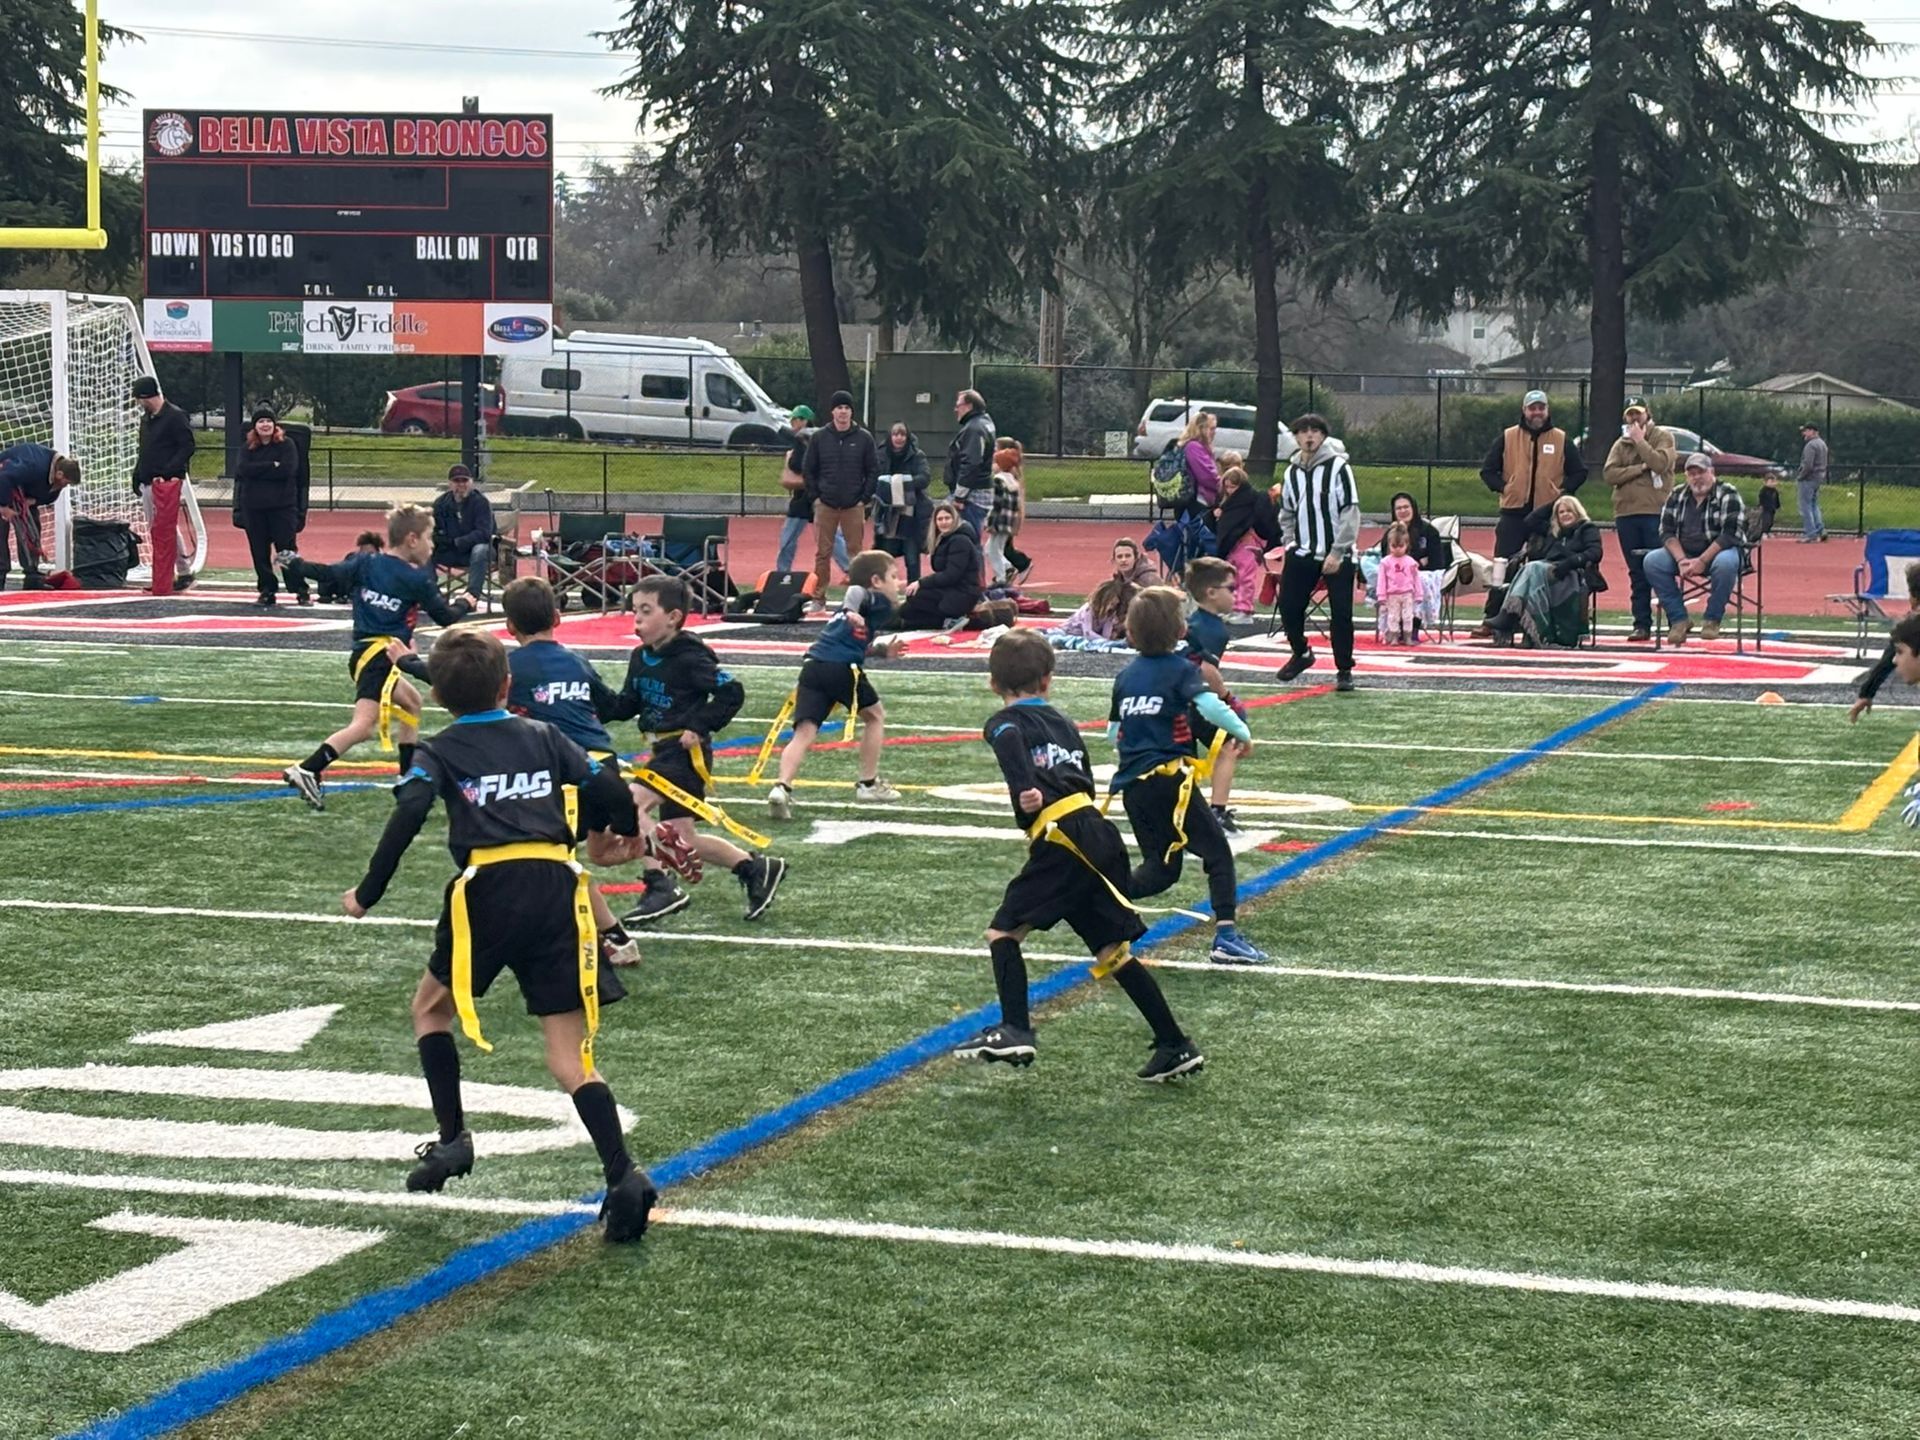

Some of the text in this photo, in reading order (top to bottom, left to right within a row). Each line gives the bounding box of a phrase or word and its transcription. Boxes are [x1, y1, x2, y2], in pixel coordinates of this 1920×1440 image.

[199, 116, 548, 157] BELLA VISTA BRONCOS
[151, 232, 200, 257] DOWN
[211, 233, 294, 258] YDS TO GO
[416, 235, 479, 261] BALL ON
[506, 236, 538, 261] QTR
[358, 312, 428, 336] Fiddle
[305, 342, 334, 351] DRINK
[365, 589, 403, 612] FLAG
[547, 681, 591, 705] FLAG
[1119, 695, 1164, 720] FLAG
[478, 769, 553, 808] FLAG
